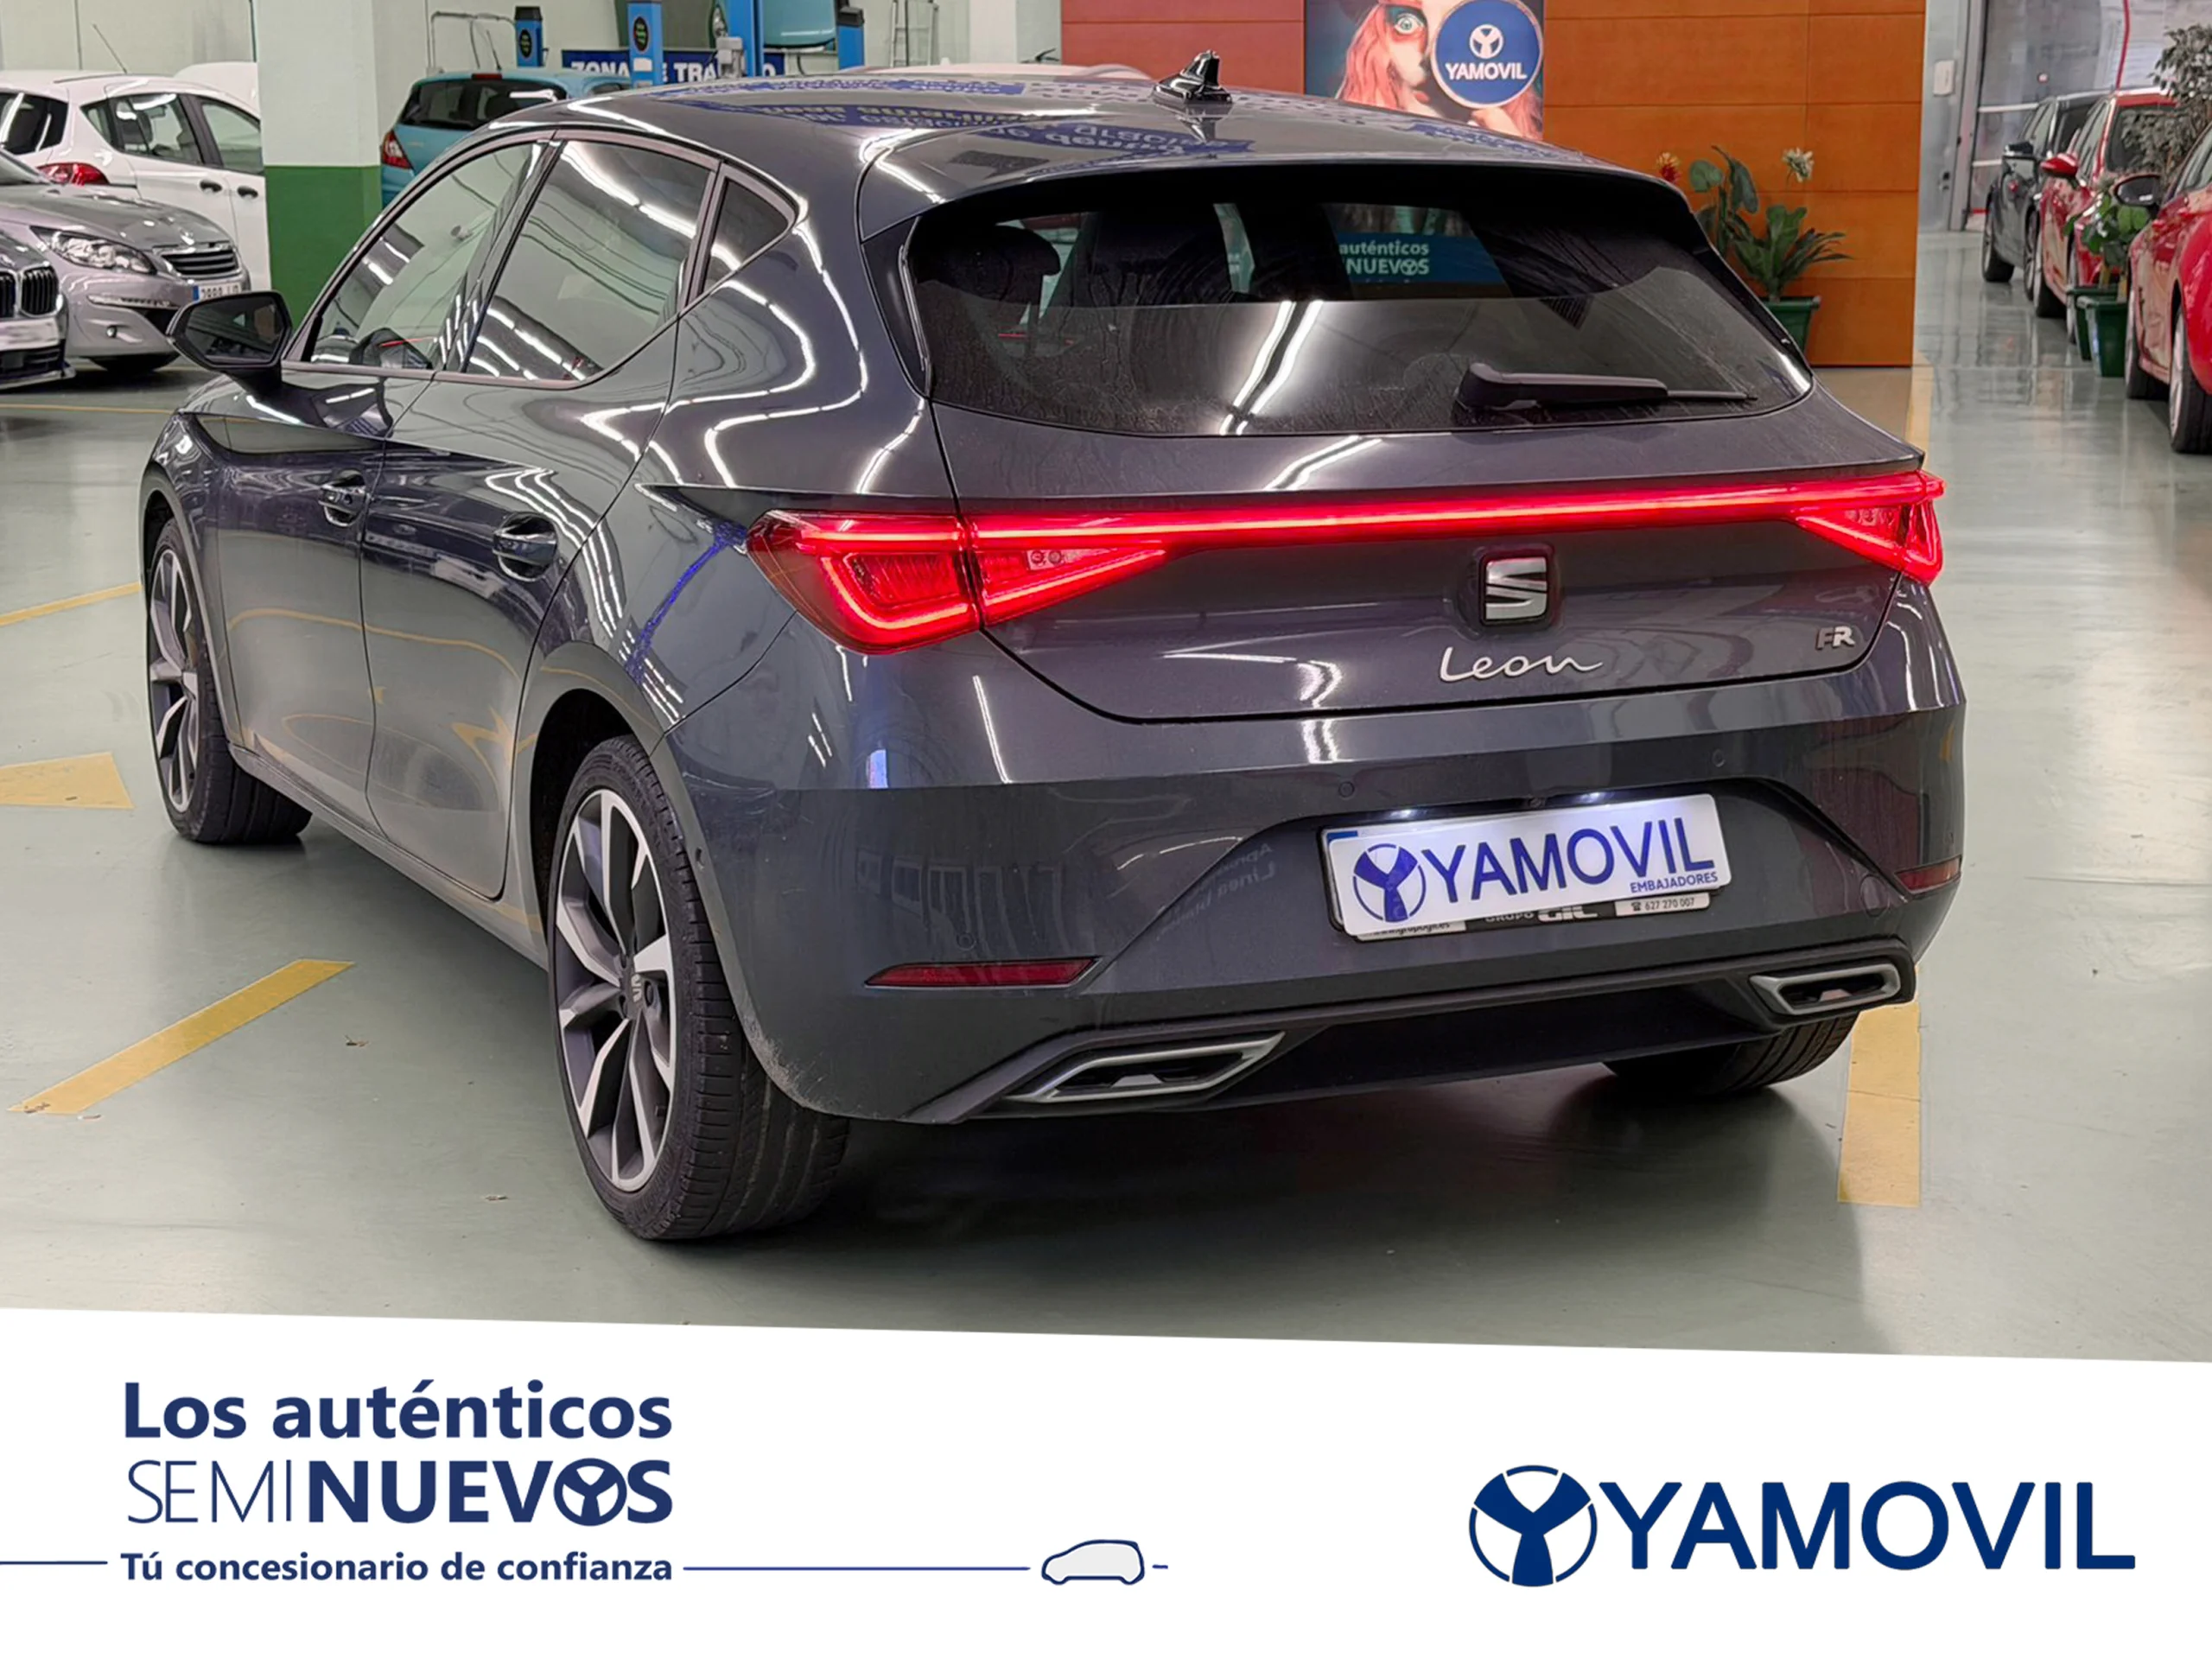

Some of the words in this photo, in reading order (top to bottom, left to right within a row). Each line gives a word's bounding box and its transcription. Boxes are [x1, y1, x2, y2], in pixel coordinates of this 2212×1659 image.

[1444, 61, 1528, 80] YAMOVIL
[1338, 239, 1430, 256] auténticos
[1815, 626, 1856, 651] FR
[1440, 646, 1604, 683] Leon
[1421, 817, 1715, 904] YAMOVIL
[1630, 871, 1719, 893] EMBAJADORES
[1643, 899, 1660, 910] 627
[1662, 897, 1679, 909] 270
